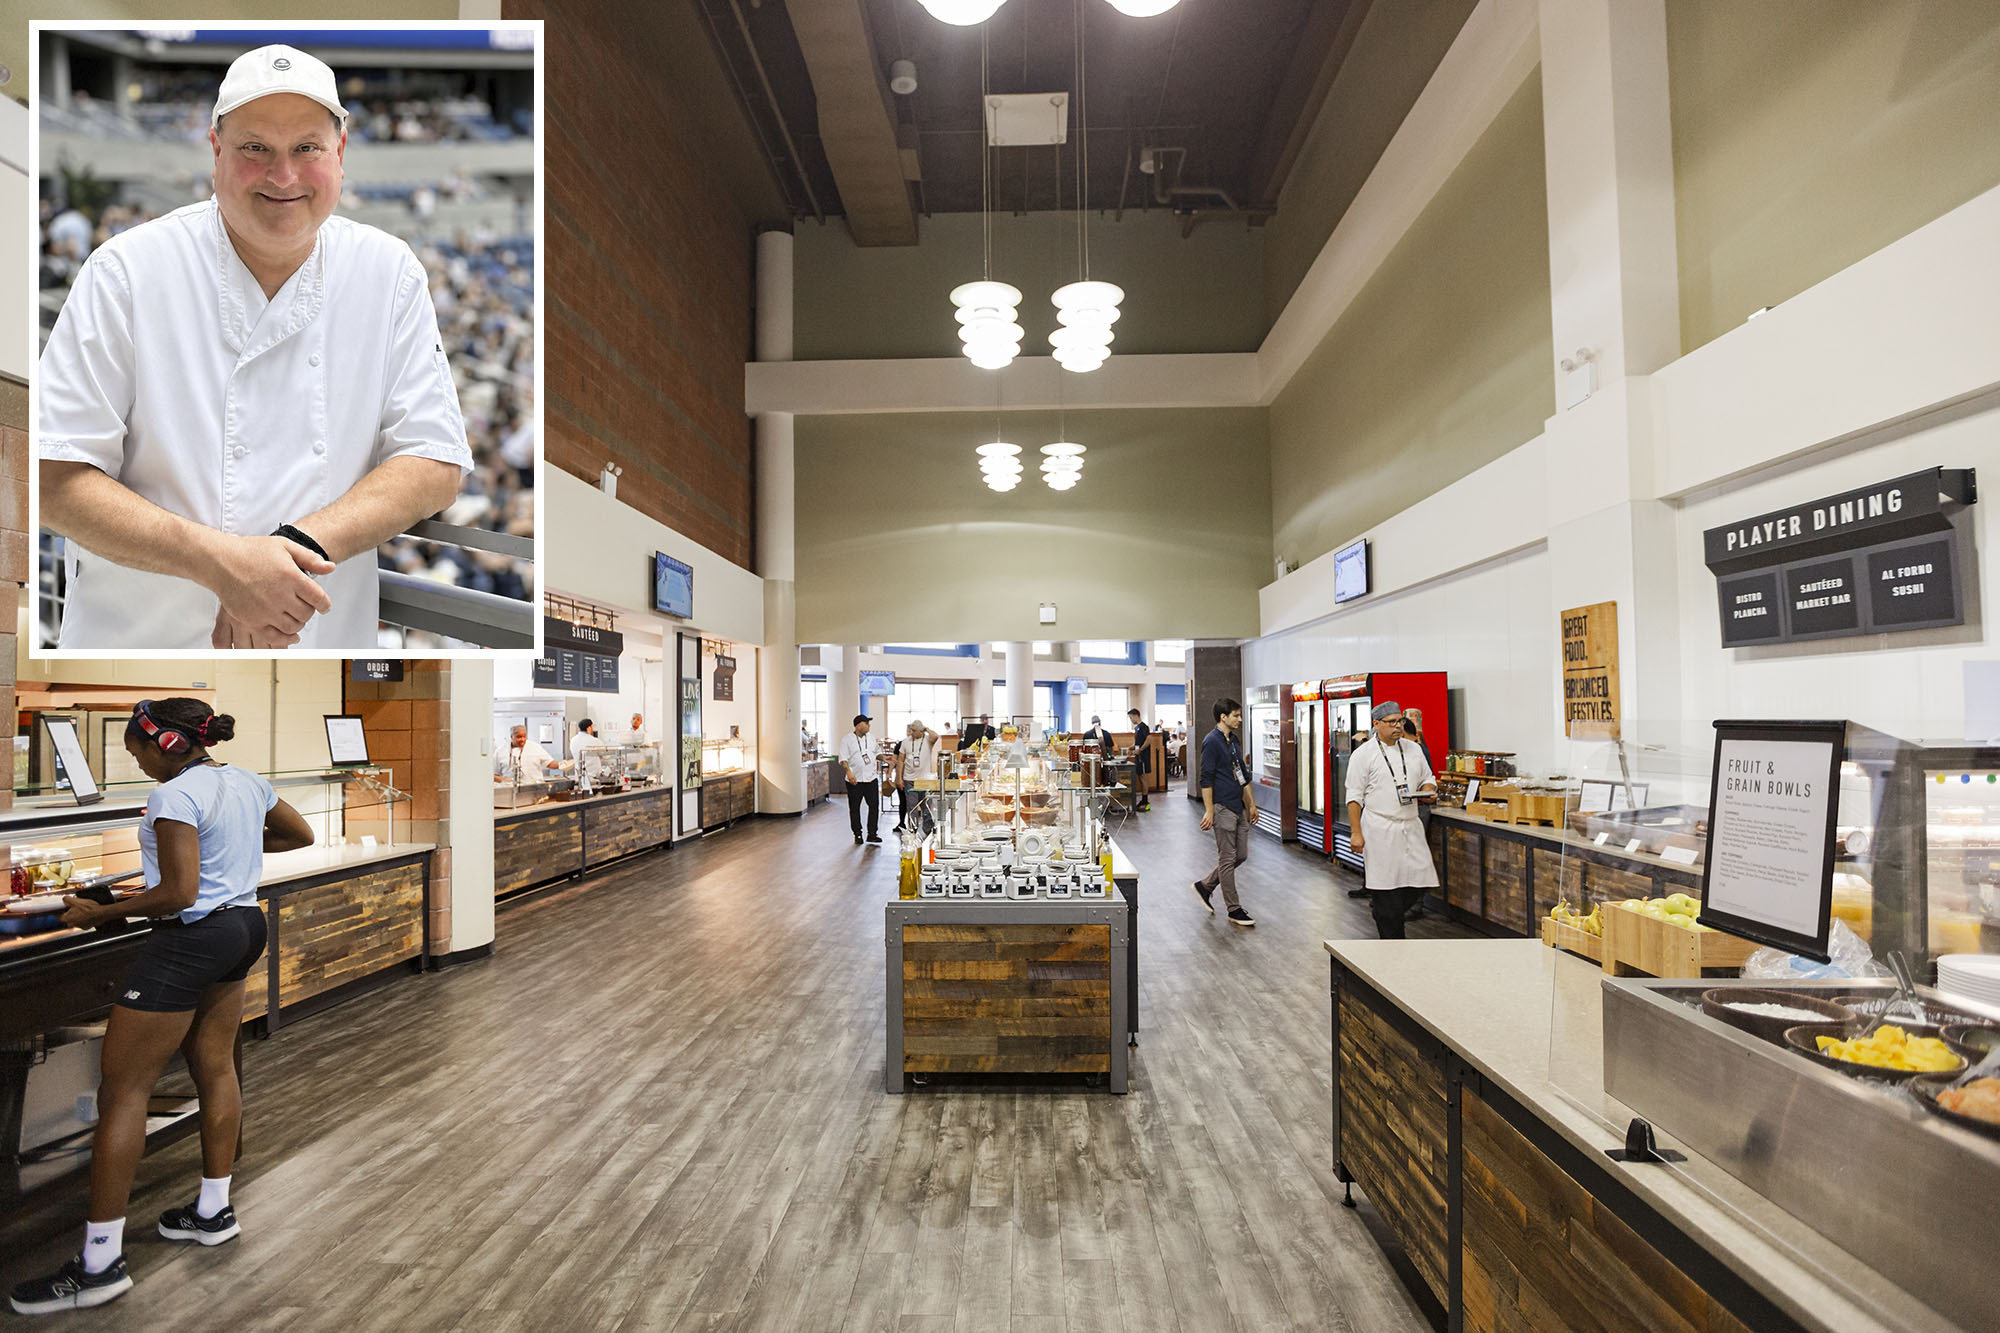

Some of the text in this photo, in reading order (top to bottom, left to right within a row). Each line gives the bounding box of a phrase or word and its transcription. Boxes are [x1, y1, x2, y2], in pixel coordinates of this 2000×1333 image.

[1726, 489, 1902, 551] PLAYER DINING
[1881, 563, 1933, 580] AL FORNO
[1735, 592, 1762, 604] BISTRO
[1892, 583, 1925, 597] SUSHI
[1796, 593, 1851, 610] MARKET BAR
[1733, 606, 1768, 619] PLANCHA
[571, 626, 600, 642] SAUTÉED
[1563, 615, 1588, 639] GREAT
[1564, 640, 1588, 662] FOOD.
[366, 662, 390, 672] ORDER
[1566, 676, 1608, 699] BALANCED
[1727, 759, 1775, 775] FRUIT &
[1726, 777, 1811, 798] GRAIN BOWLS
